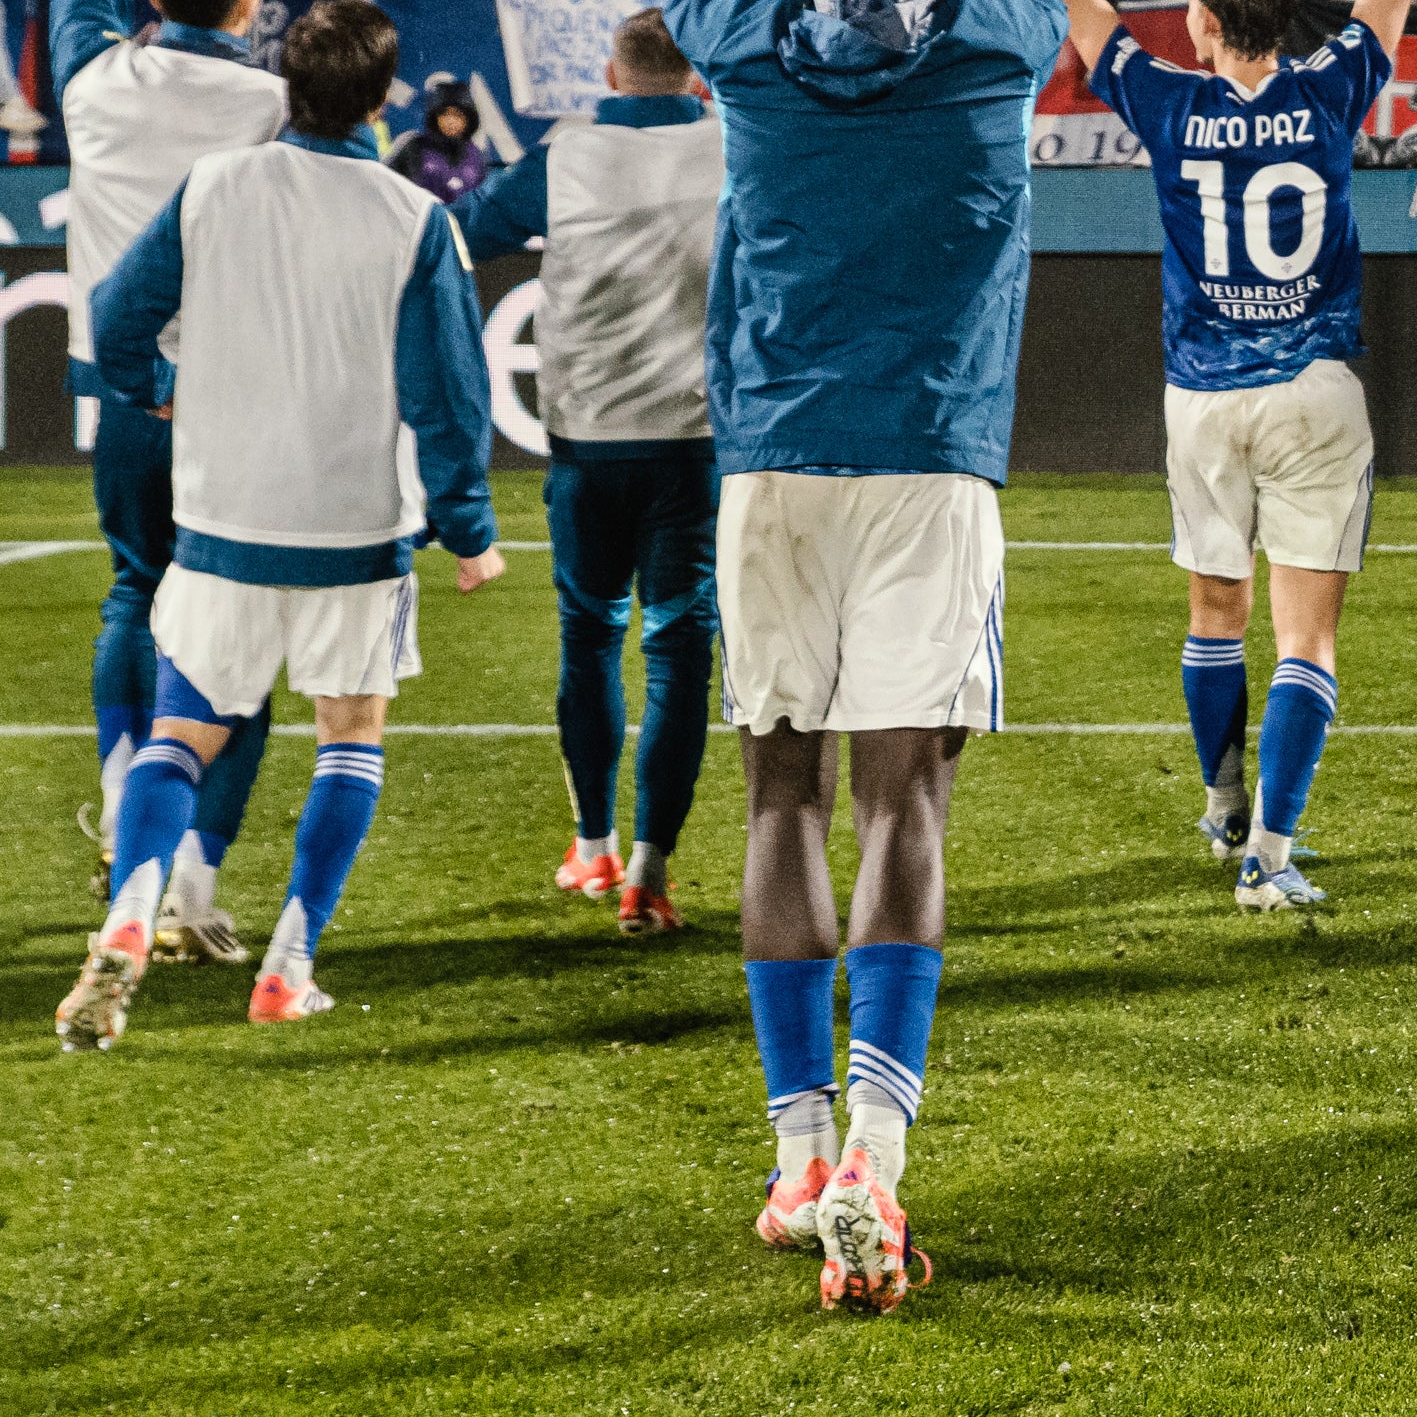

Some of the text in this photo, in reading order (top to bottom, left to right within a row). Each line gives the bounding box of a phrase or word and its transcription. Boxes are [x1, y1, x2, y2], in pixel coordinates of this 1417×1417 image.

[1184, 109, 1316, 149] NICO PAZ
[1180, 159, 1329, 281] 10
[1198, 273, 1323, 302] NEUBERGER
[1218, 299, 1306, 320] BERMAN
